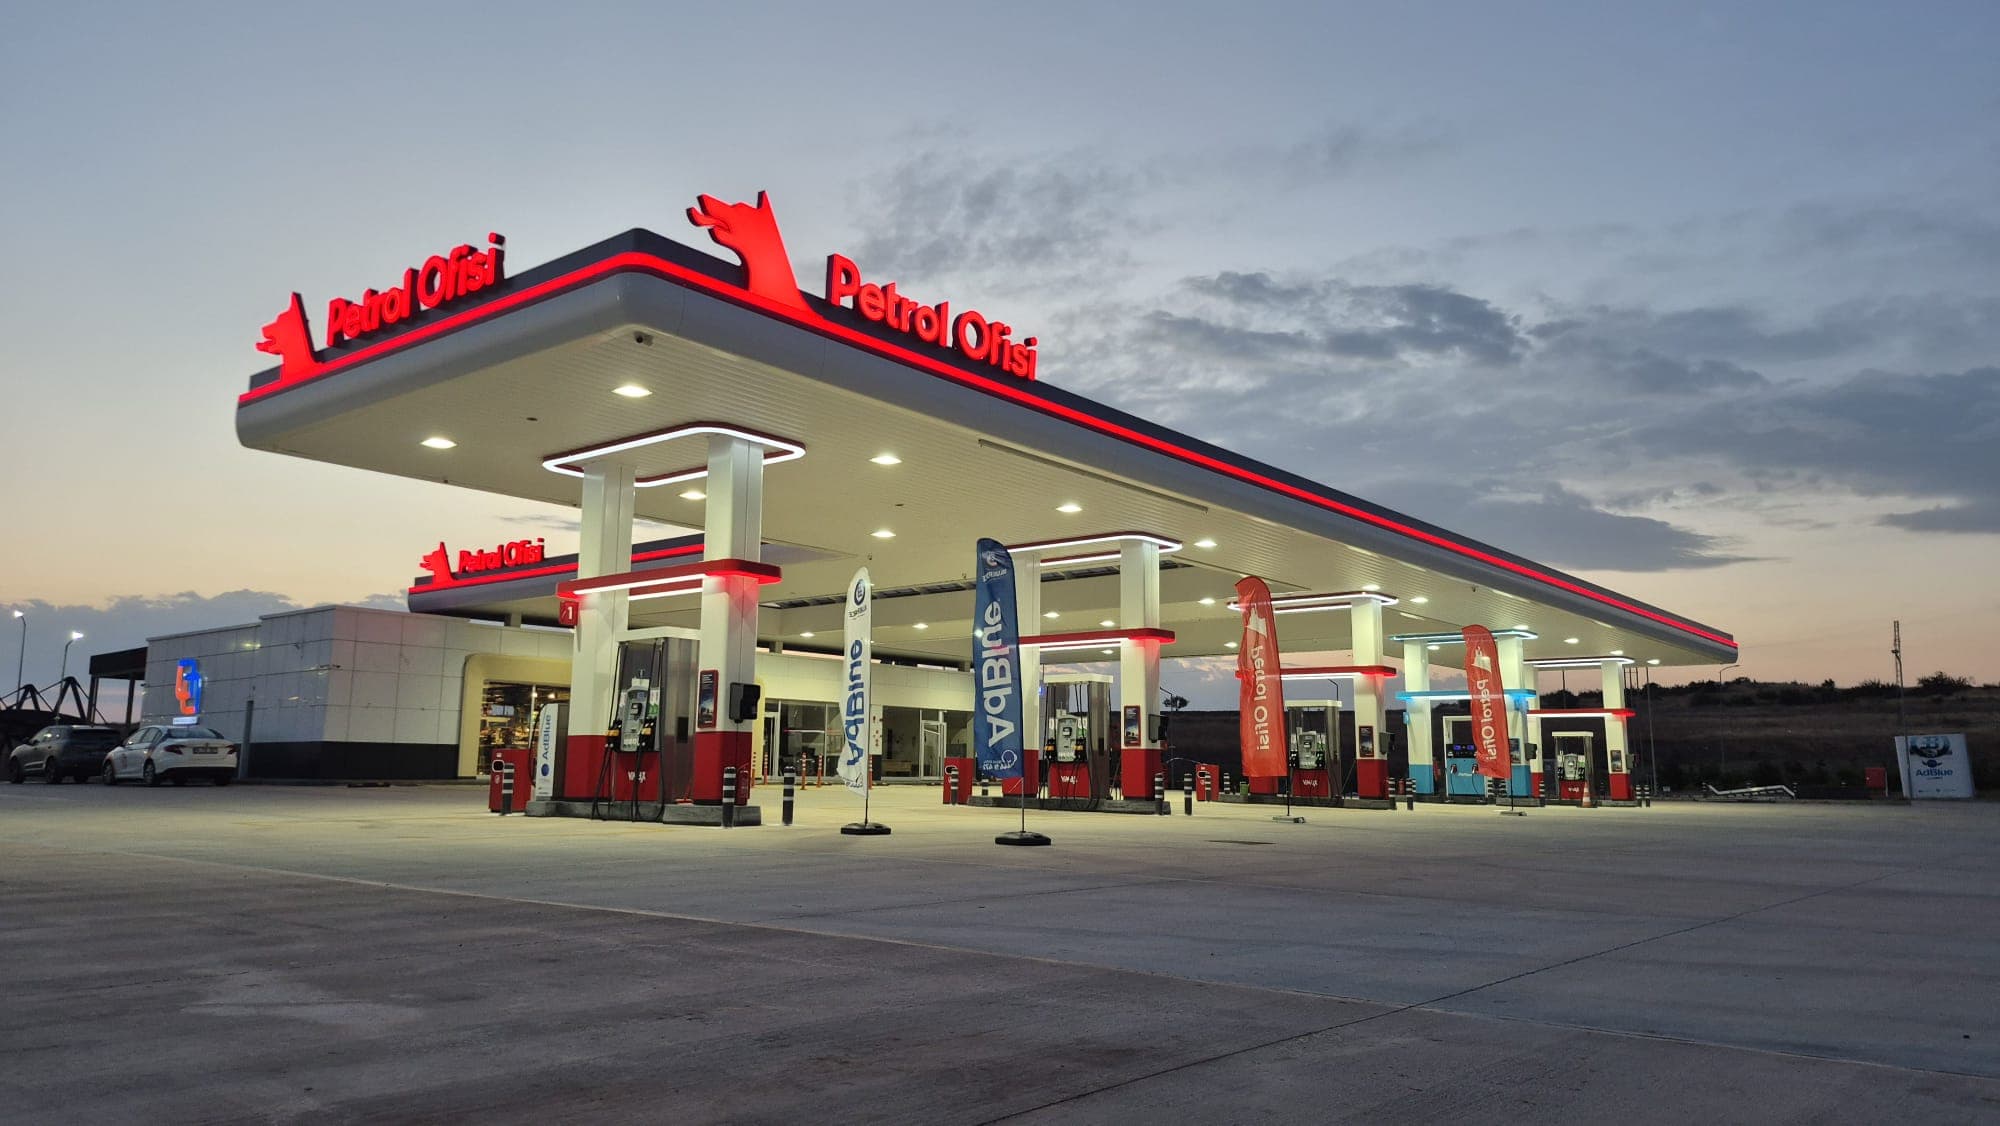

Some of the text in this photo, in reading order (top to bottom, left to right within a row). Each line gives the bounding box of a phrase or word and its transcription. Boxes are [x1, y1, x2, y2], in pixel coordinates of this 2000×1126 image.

[326, 232, 503, 347] Petrol Ofisi
[826, 253, 1038, 381] Petrol Ofisi
[459, 538, 544, 575] Petrol Ofisi
[567, 606, 573, 620] 1
[542, 714, 552, 760] AdBlue
